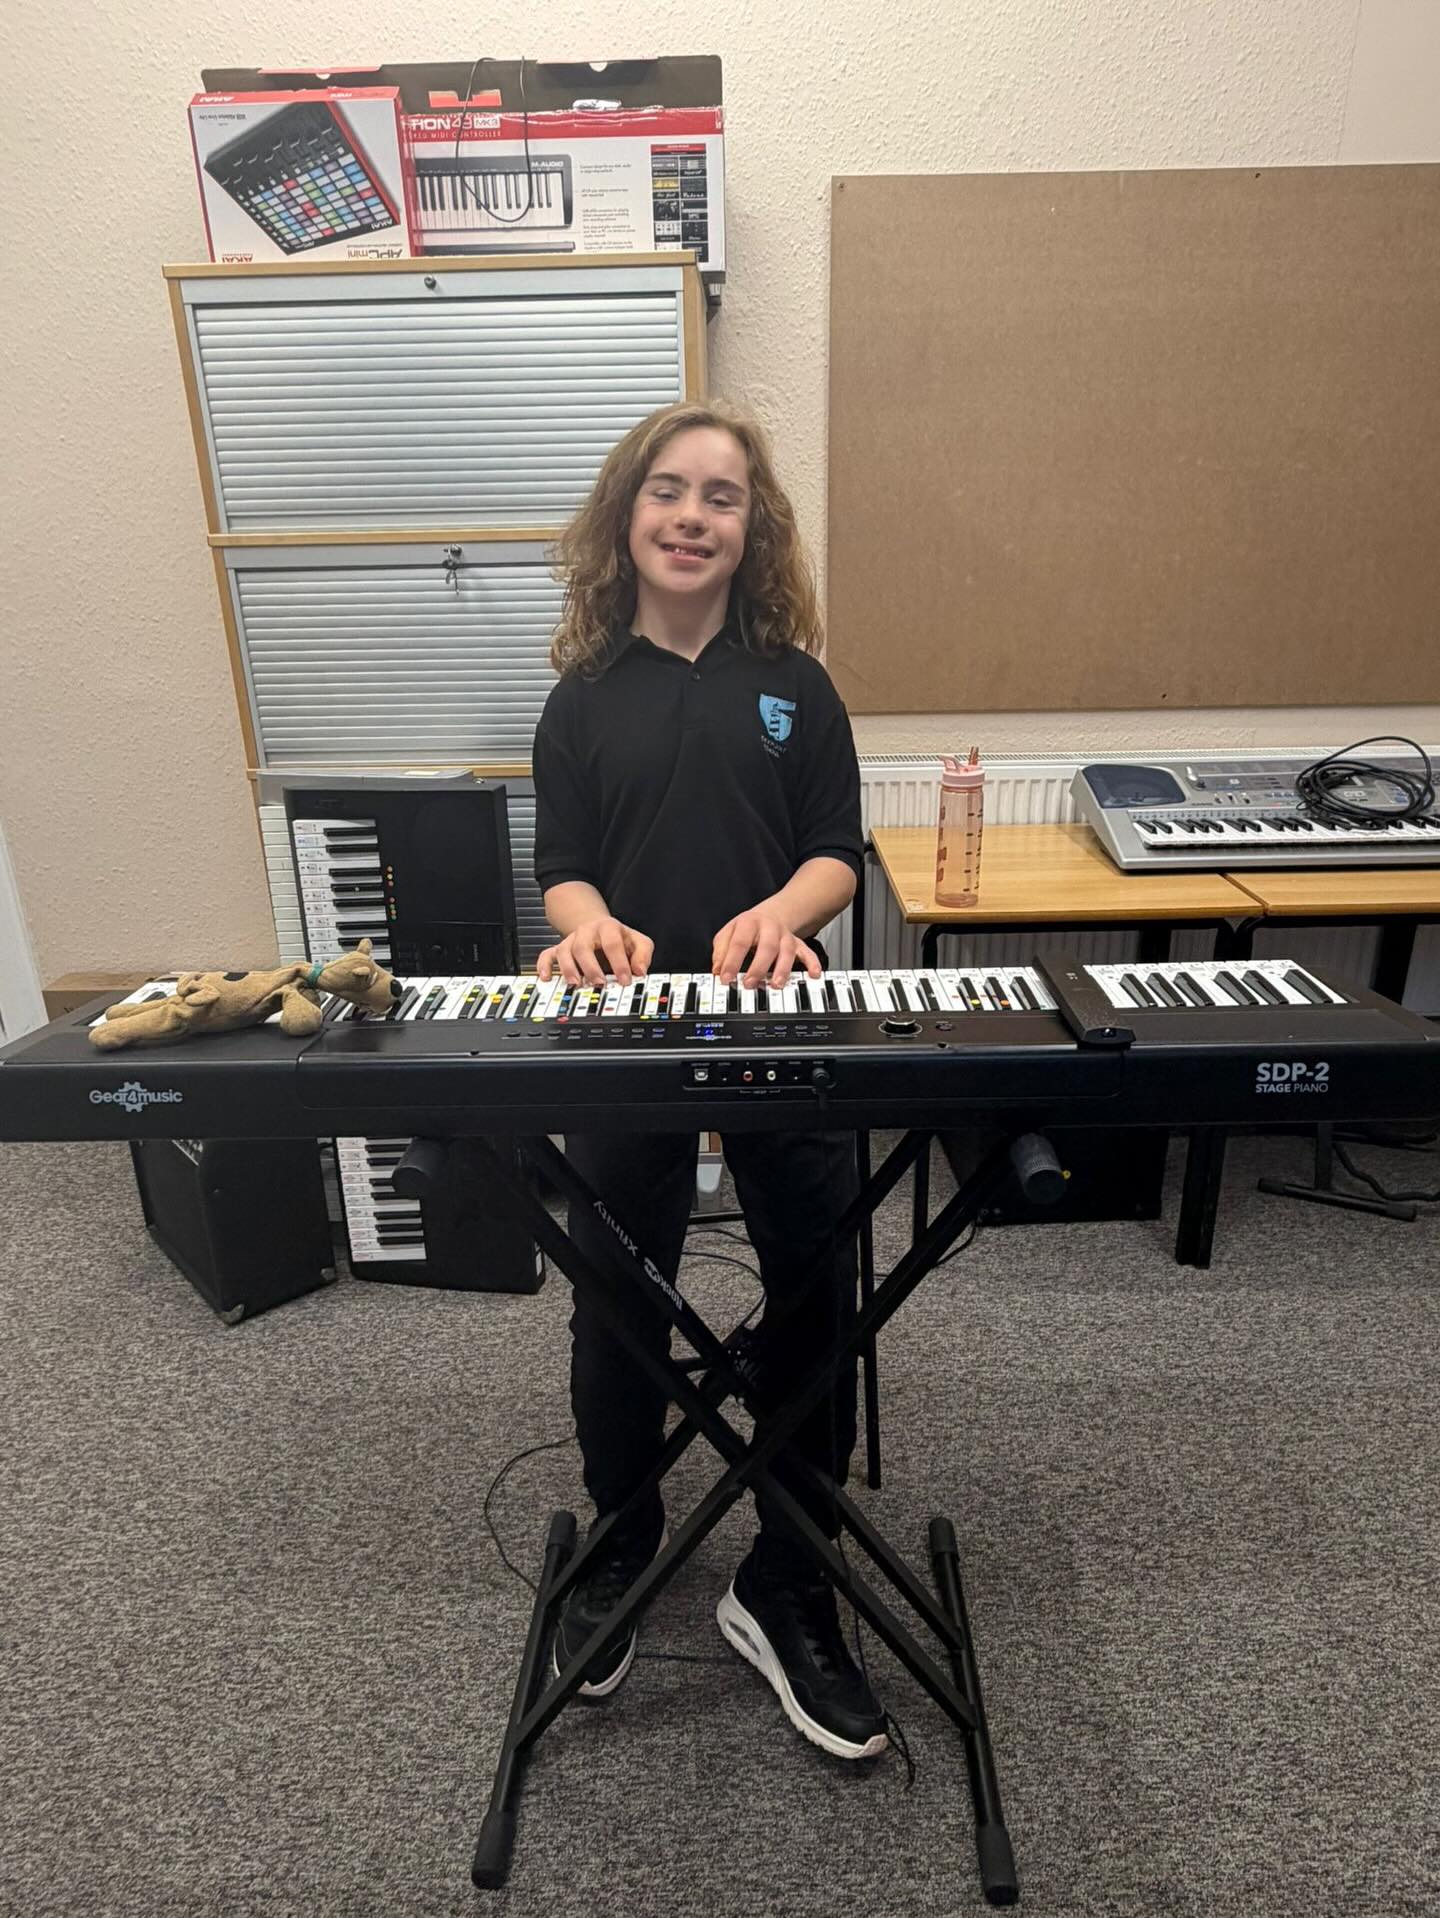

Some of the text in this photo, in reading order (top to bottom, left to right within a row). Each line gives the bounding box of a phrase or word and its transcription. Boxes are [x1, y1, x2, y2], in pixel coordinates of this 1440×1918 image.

[1256, 1062, 1330, 1082] SDP-2
[1255, 1082, 1329, 1093] STAGE PIANO
[88, 1088, 183, 1105] Gear4music
